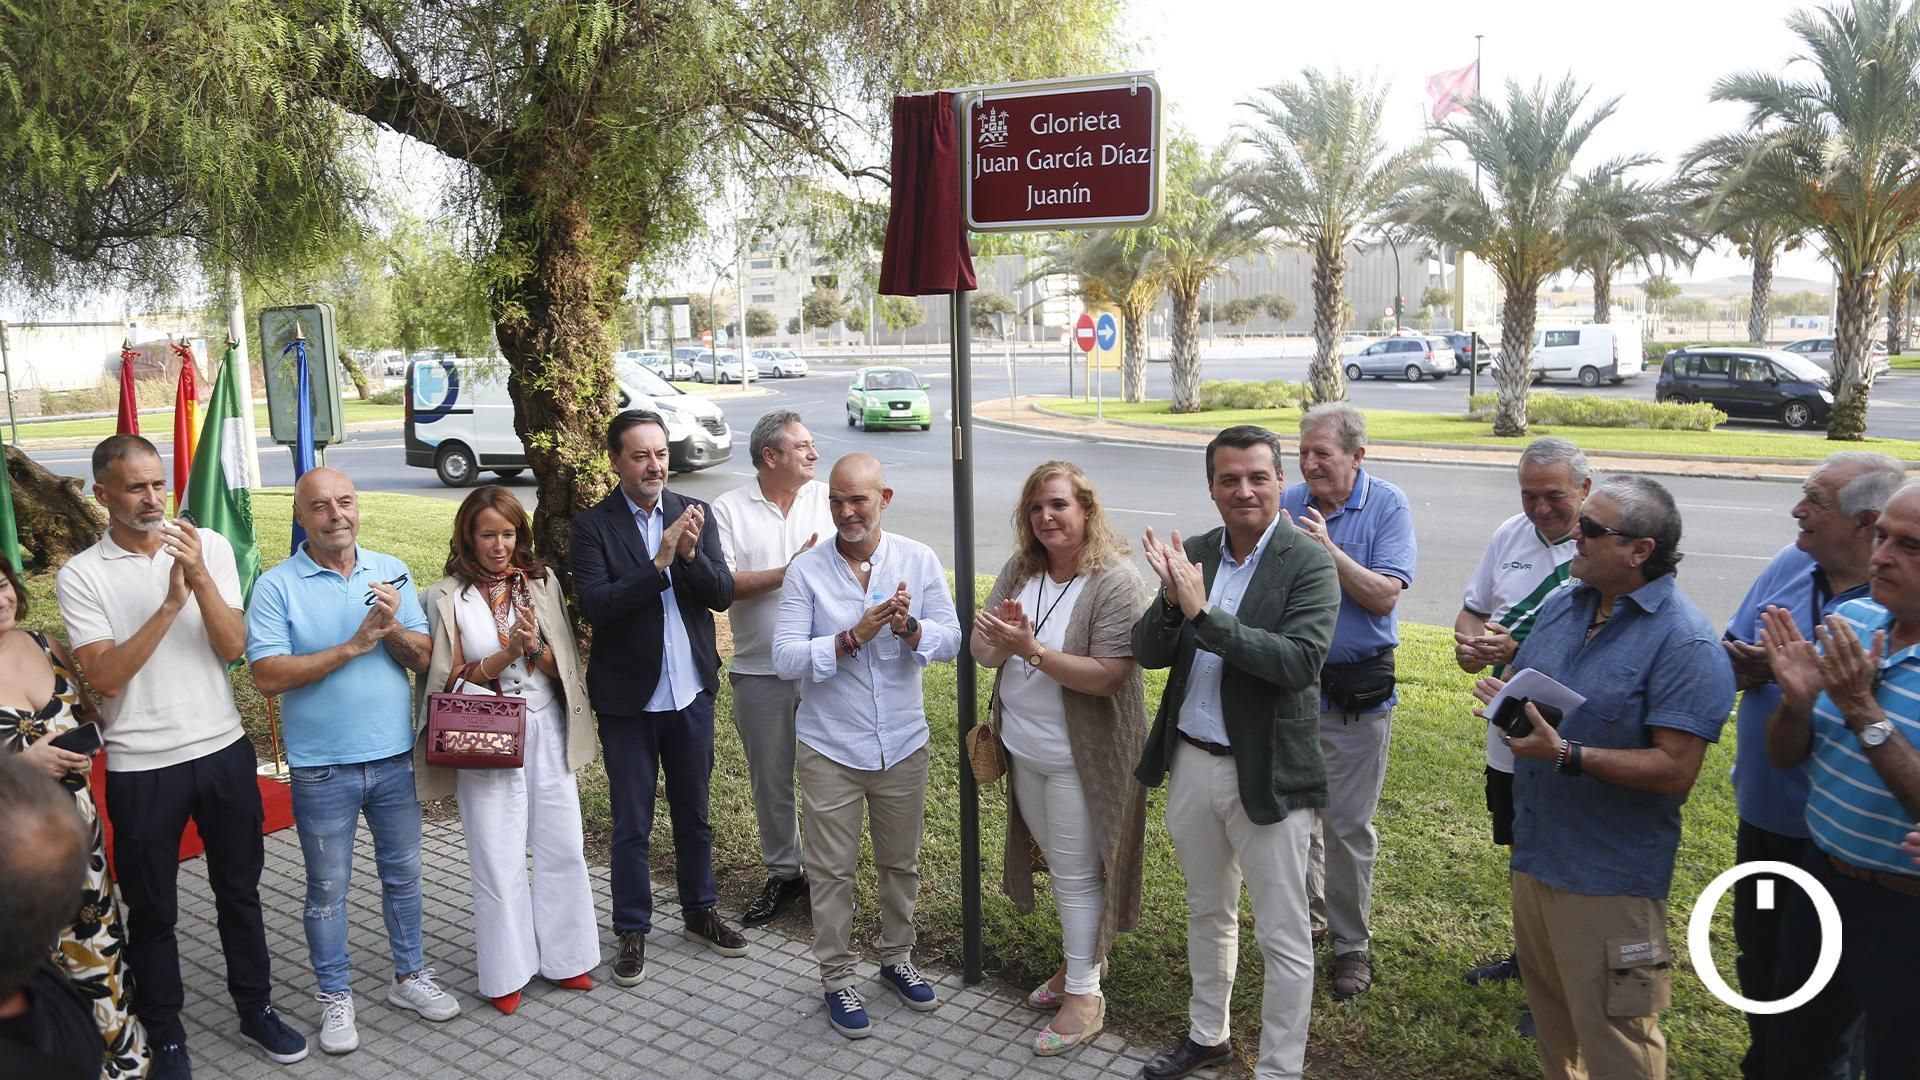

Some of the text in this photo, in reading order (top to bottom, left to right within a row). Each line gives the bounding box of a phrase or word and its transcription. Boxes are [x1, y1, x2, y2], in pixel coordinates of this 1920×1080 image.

[1030, 111, 1121, 135] Glorieta
[975, 142, 1150, 179] Juan García Díaz
[1026, 181, 1091, 211] Juanín
